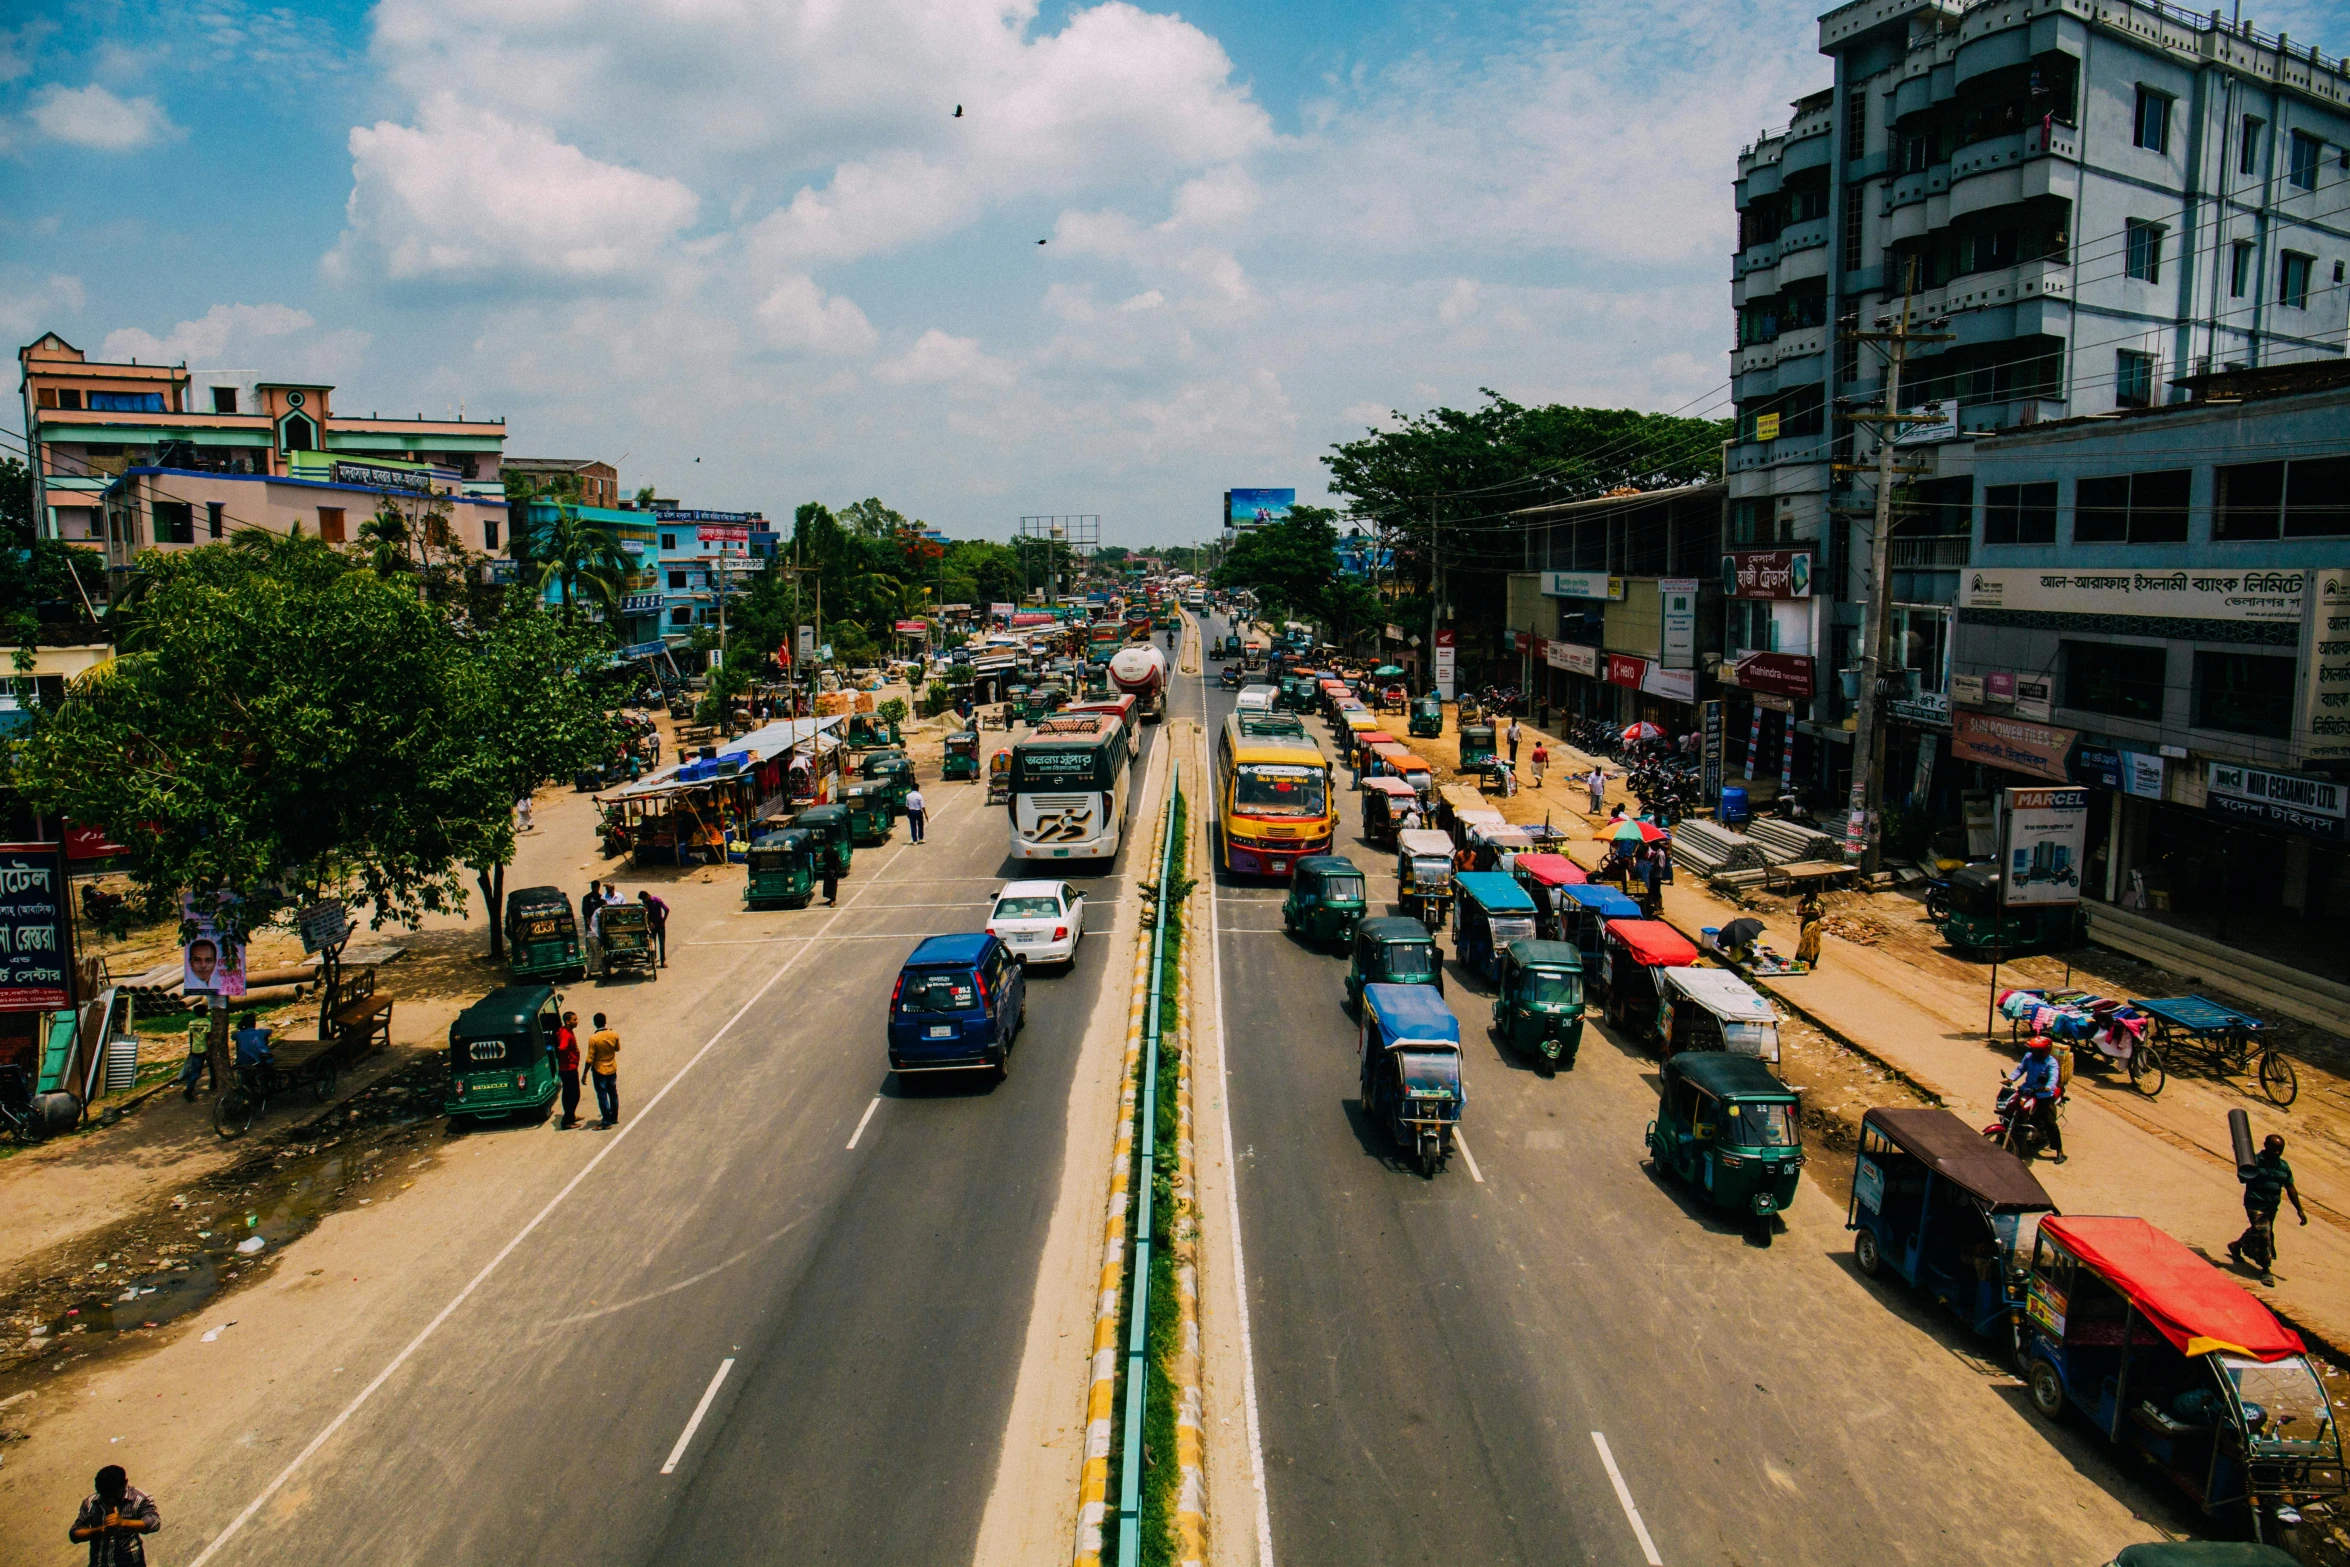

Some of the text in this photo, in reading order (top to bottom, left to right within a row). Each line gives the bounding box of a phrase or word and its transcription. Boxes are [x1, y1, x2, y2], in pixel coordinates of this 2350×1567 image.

[1736, 563, 1791, 588] হাজী ট্রেডার্স
[2133, 573, 2187, 592] ইসলামী
[2193, 577, 2238, 593] ব্যাংক
[2244, 573, 2303, 593] লিমিটে
[1749, 664, 1782, 679] Mahindra
[1969, 718, 2051, 747] SUN POWER TILES
[1025, 755, 1060, 765] অনন্যা
[2017, 793, 2086, 806] MARCEL
[2247, 772, 2267, 796] MIR
[2268, 776, 2315, 806] CERAMIC
[2317, 784, 2338, 811] LTD.
[2214, 795, 2266, 817] স্বদেশ
[17, 902, 56, 918] (আবাসিক)
[15, 966, 63, 982] সেন্টার
[1562, 1018, 1572, 1028] CNG
[1783, 1163, 1795, 1175] CNG
